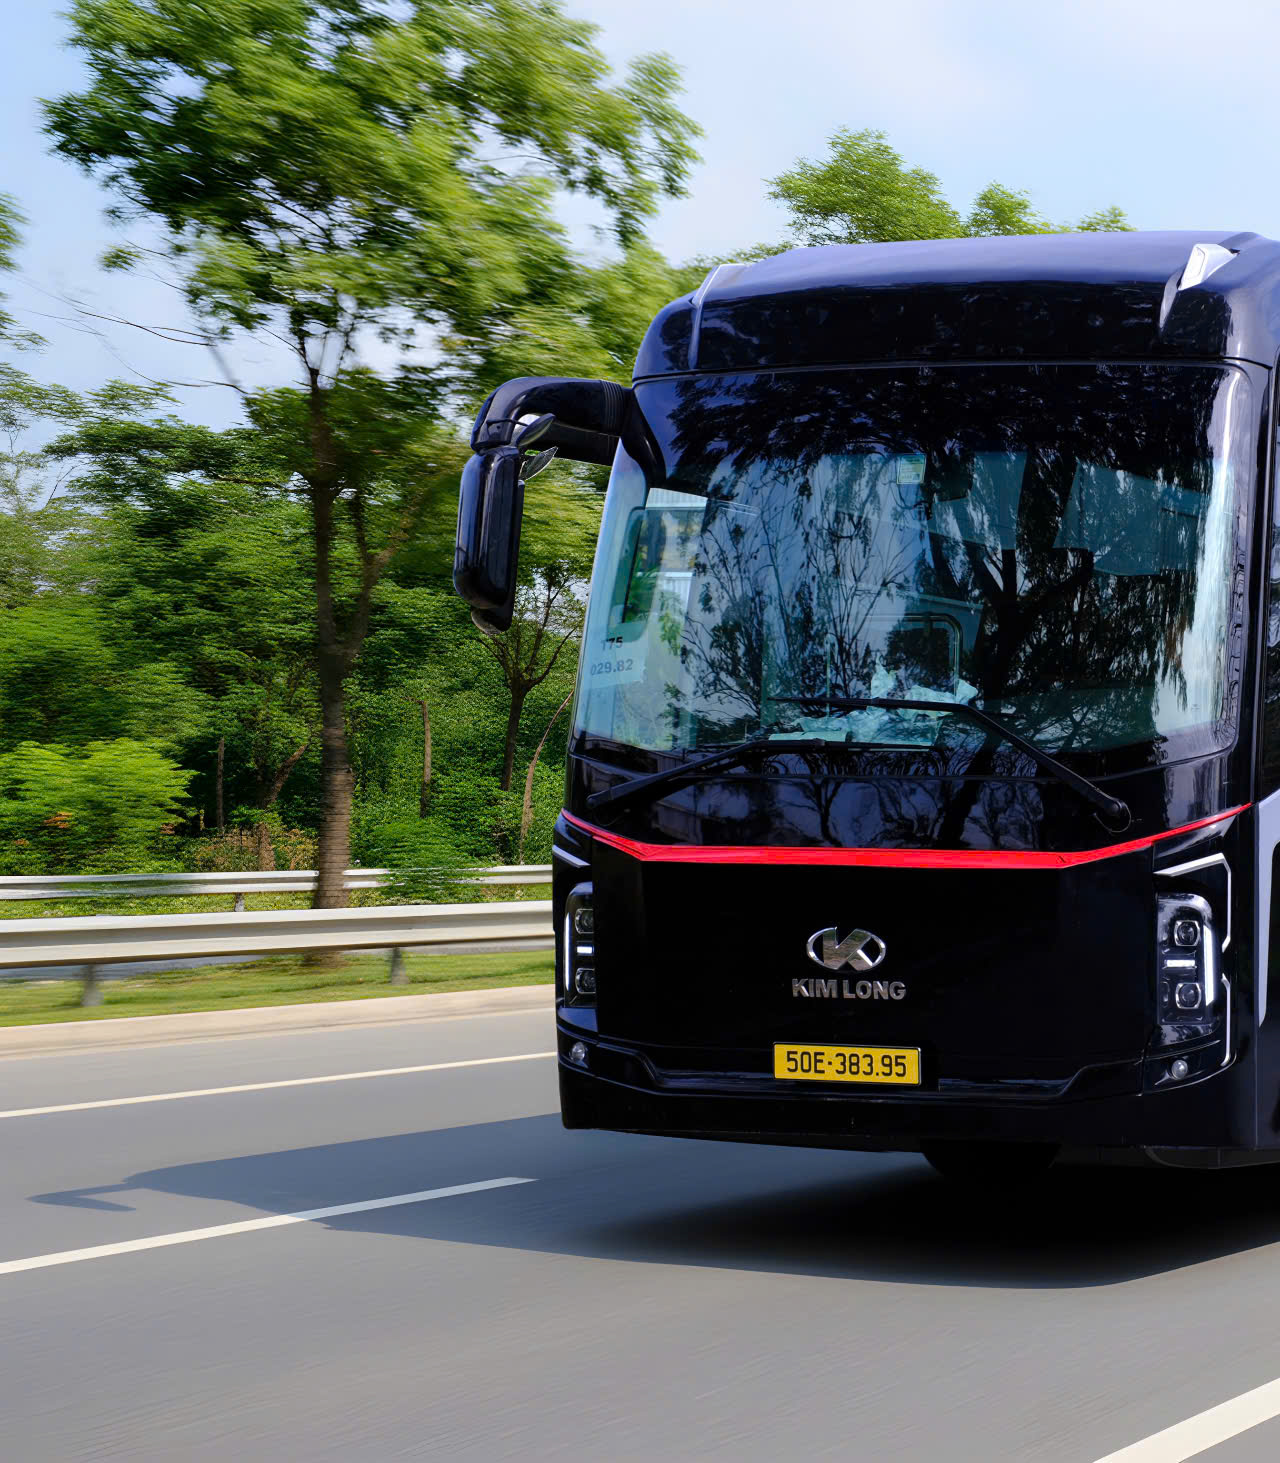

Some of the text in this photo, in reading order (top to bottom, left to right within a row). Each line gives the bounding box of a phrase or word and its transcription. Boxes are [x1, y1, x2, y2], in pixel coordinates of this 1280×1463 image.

[792, 978, 907, 1000] KIM LONG
[786, 1051, 907, 1077] 50E-383.95
